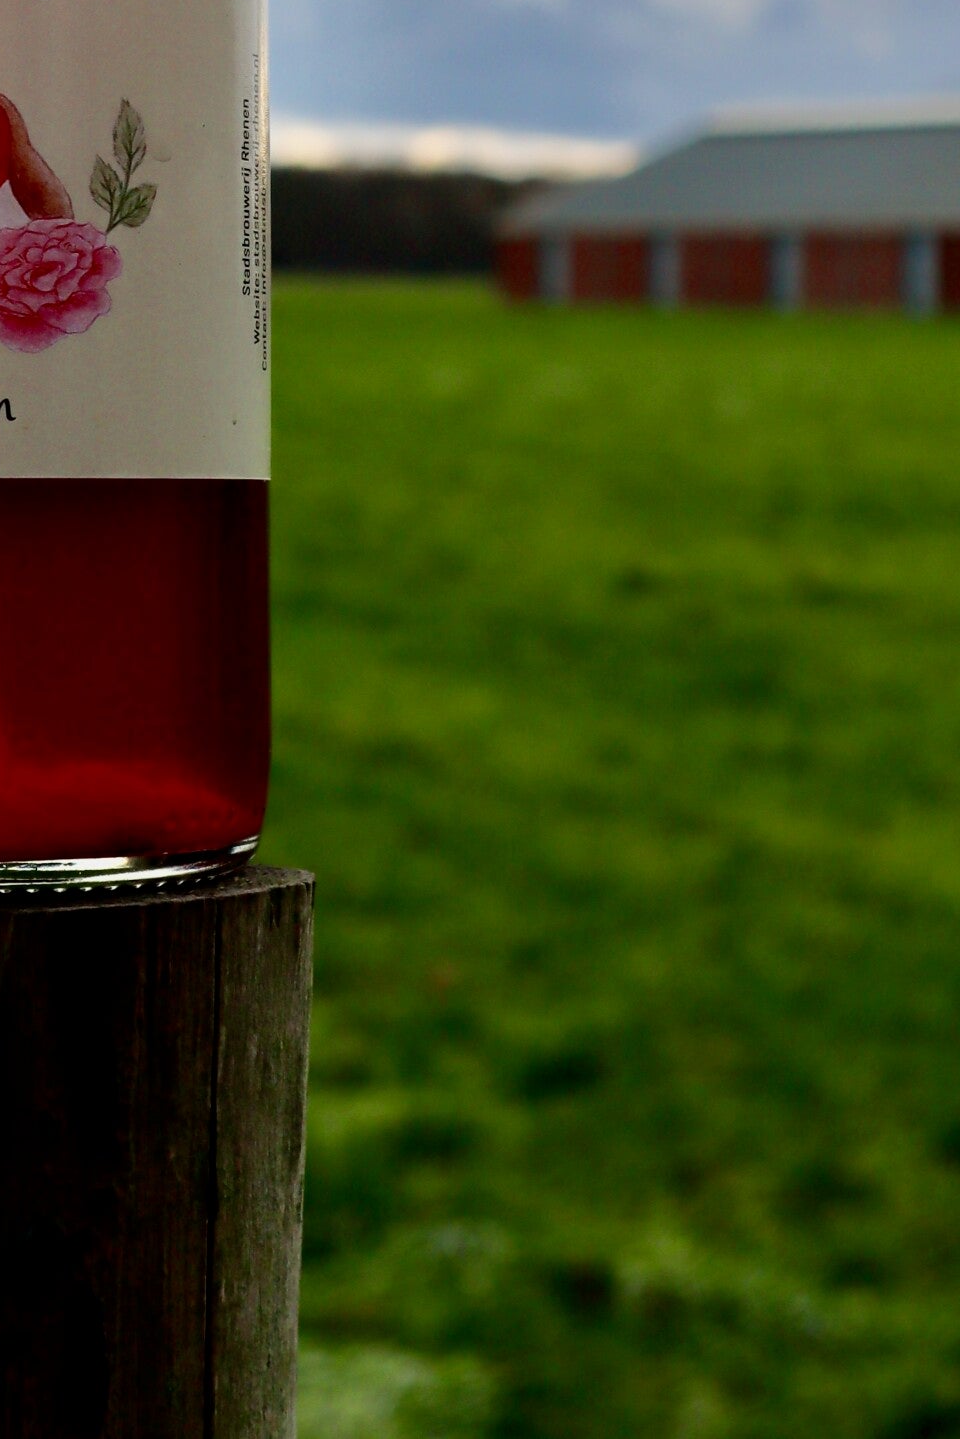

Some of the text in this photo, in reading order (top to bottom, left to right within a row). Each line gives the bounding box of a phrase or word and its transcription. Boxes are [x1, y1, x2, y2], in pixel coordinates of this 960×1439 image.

[241, 98, 252, 296] Stadsbrouwerij Rhenen
[253, 272, 261, 345] Website:
